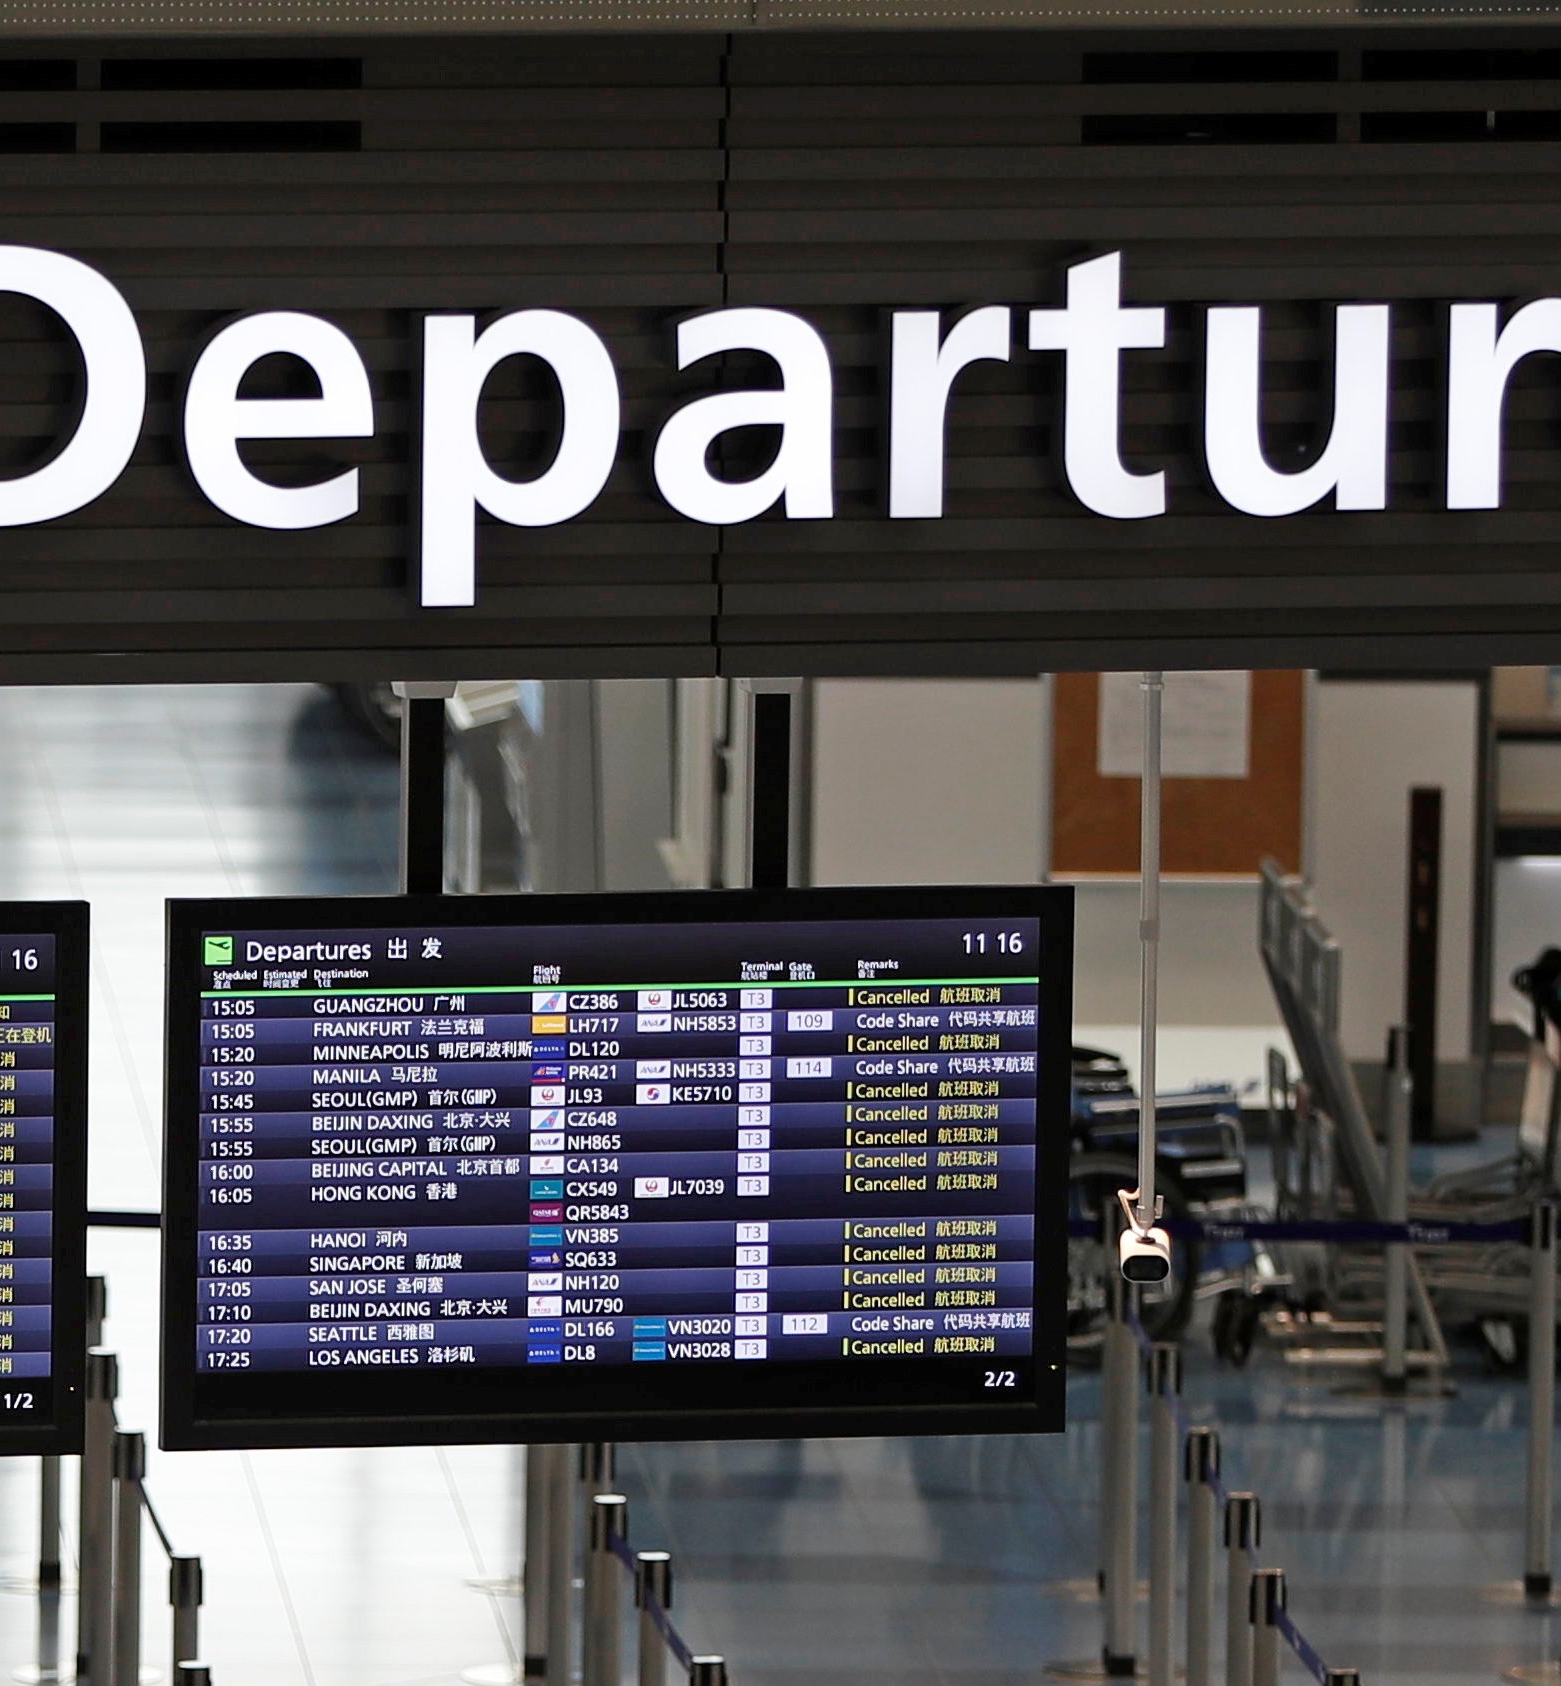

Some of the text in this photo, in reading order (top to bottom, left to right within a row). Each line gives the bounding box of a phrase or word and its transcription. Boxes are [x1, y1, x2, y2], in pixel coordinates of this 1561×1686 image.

[246, 941, 372, 963] Departures
[533, 964, 561, 976] Flight
[740, 961, 784, 971] Terminal
[789, 962, 813, 971] Gate
[857, 959, 899, 970] Remarks
[212, 970, 258, 980] Scheduled
[263, 969, 308, 980] Estimated
[313, 968, 369, 980] Destination
[313, 997, 424, 1014] GUANGZHOU
[569, 993, 619, 1010] CZ386
[673, 992, 728, 1009] JL5063
[569, 1017, 619, 1034] LH717
[673, 1015, 737, 1032] NH5853
[856, 1012, 940, 1029] Code Share
[948, 1009, 1036, 1028] 代码共享航班
[313, 1020, 413, 1037] FRANKFURT
[313, 1043, 430, 1061] MINNEAPOLIS
[569, 1040, 620, 1057] DL120
[313, 1068, 381, 1085] MANILA
[568, 1064, 617, 1080] PR421
[673, 1062, 736, 1078] NH5333
[312, 1089, 418, 1108] SEOUL(GMP)
[567, 1087, 603, 1104] JL93
[672, 1085, 732, 1102] KE5710
[312, 1113, 434, 1131] BEIJIN DAXING
[567, 1110, 617, 1127] CZ648
[311, 1137, 417, 1155] SEOUL(GMP)
[567, 1134, 621, 1150] NH865
[311, 1160, 448, 1178] BEIJING CAPITAL
[566, 1157, 619, 1174] CA134
[311, 1184, 416, 1202] HONG KONG
[566, 1181, 618, 1197] CX549
[669, 1179, 725, 1196] JL7039
[565, 1204, 629, 1222] QR5843
[310, 1232, 366, 1249] HANOI
[565, 1227, 619, 1244] VN385
[309, 1255, 405, 1273] SINGAPORE
[565, 1251, 617, 1268] SQ633
[309, 1278, 386, 1296] SAN JOSE
[565, 1274, 620, 1291] NH120
[309, 1301, 431, 1319] BEIJIN DAXING
[565, 1297, 624, 1314] MU790
[308, 1325, 378, 1343] SEATTLE
[564, 1321, 615, 1337] DL166
[668, 1318, 732, 1335] VN3020
[309, 1348, 419, 1366] LOS ANGELES
[564, 1344, 596, 1361] DL8
[668, 1342, 731, 1359] VN3028
[984, 1370, 1015, 1387] 2/2
[4, 1392, 34, 1409] 1/2
